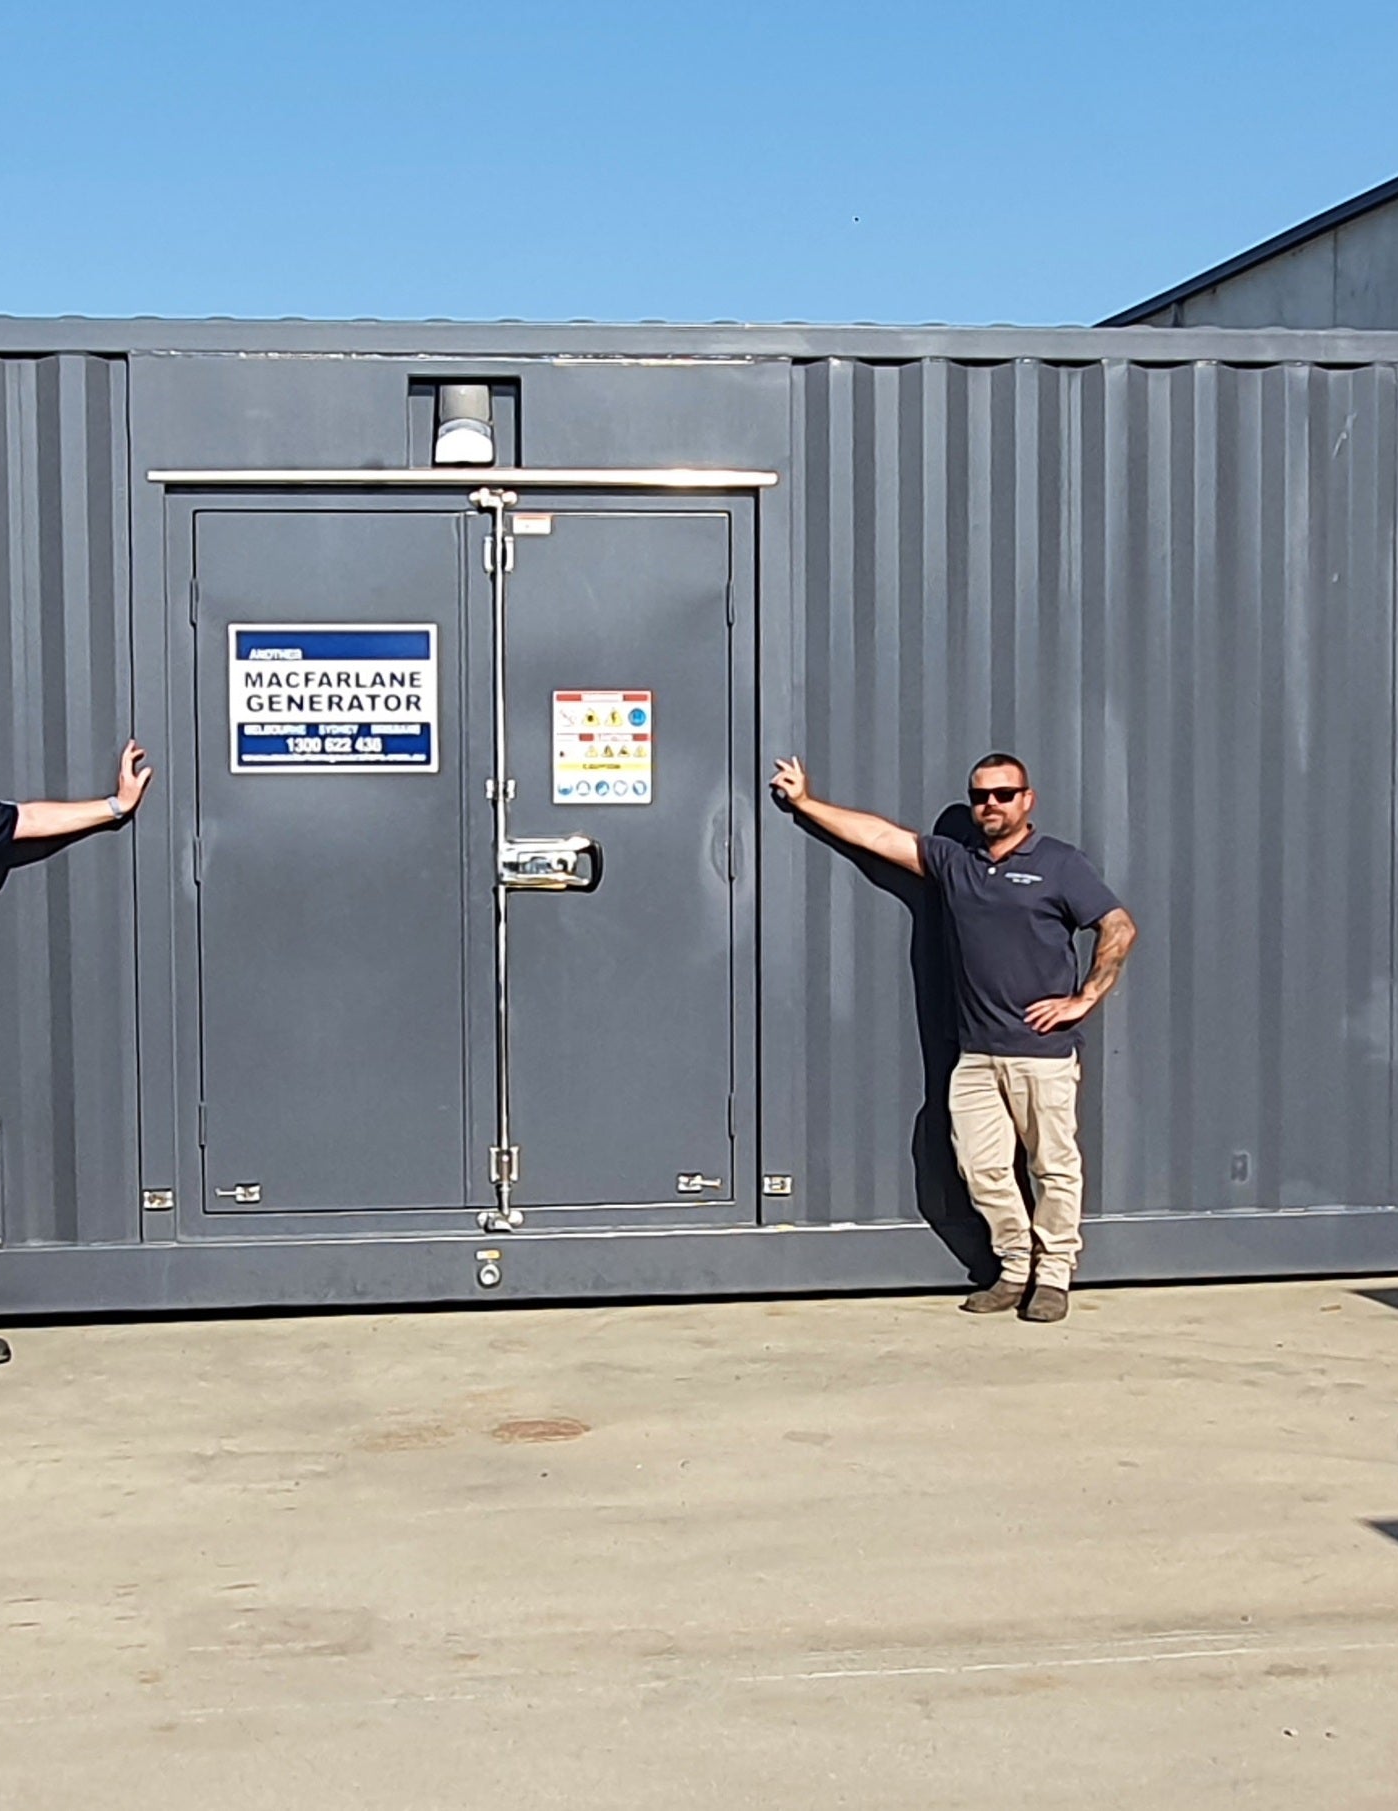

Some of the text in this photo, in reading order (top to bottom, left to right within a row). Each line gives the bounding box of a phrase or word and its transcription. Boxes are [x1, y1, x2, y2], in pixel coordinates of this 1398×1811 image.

[244, 671, 423, 689] MACFARLANE
[245, 693, 422, 712] GENERATOR
[285, 736, 322, 753] 1300
